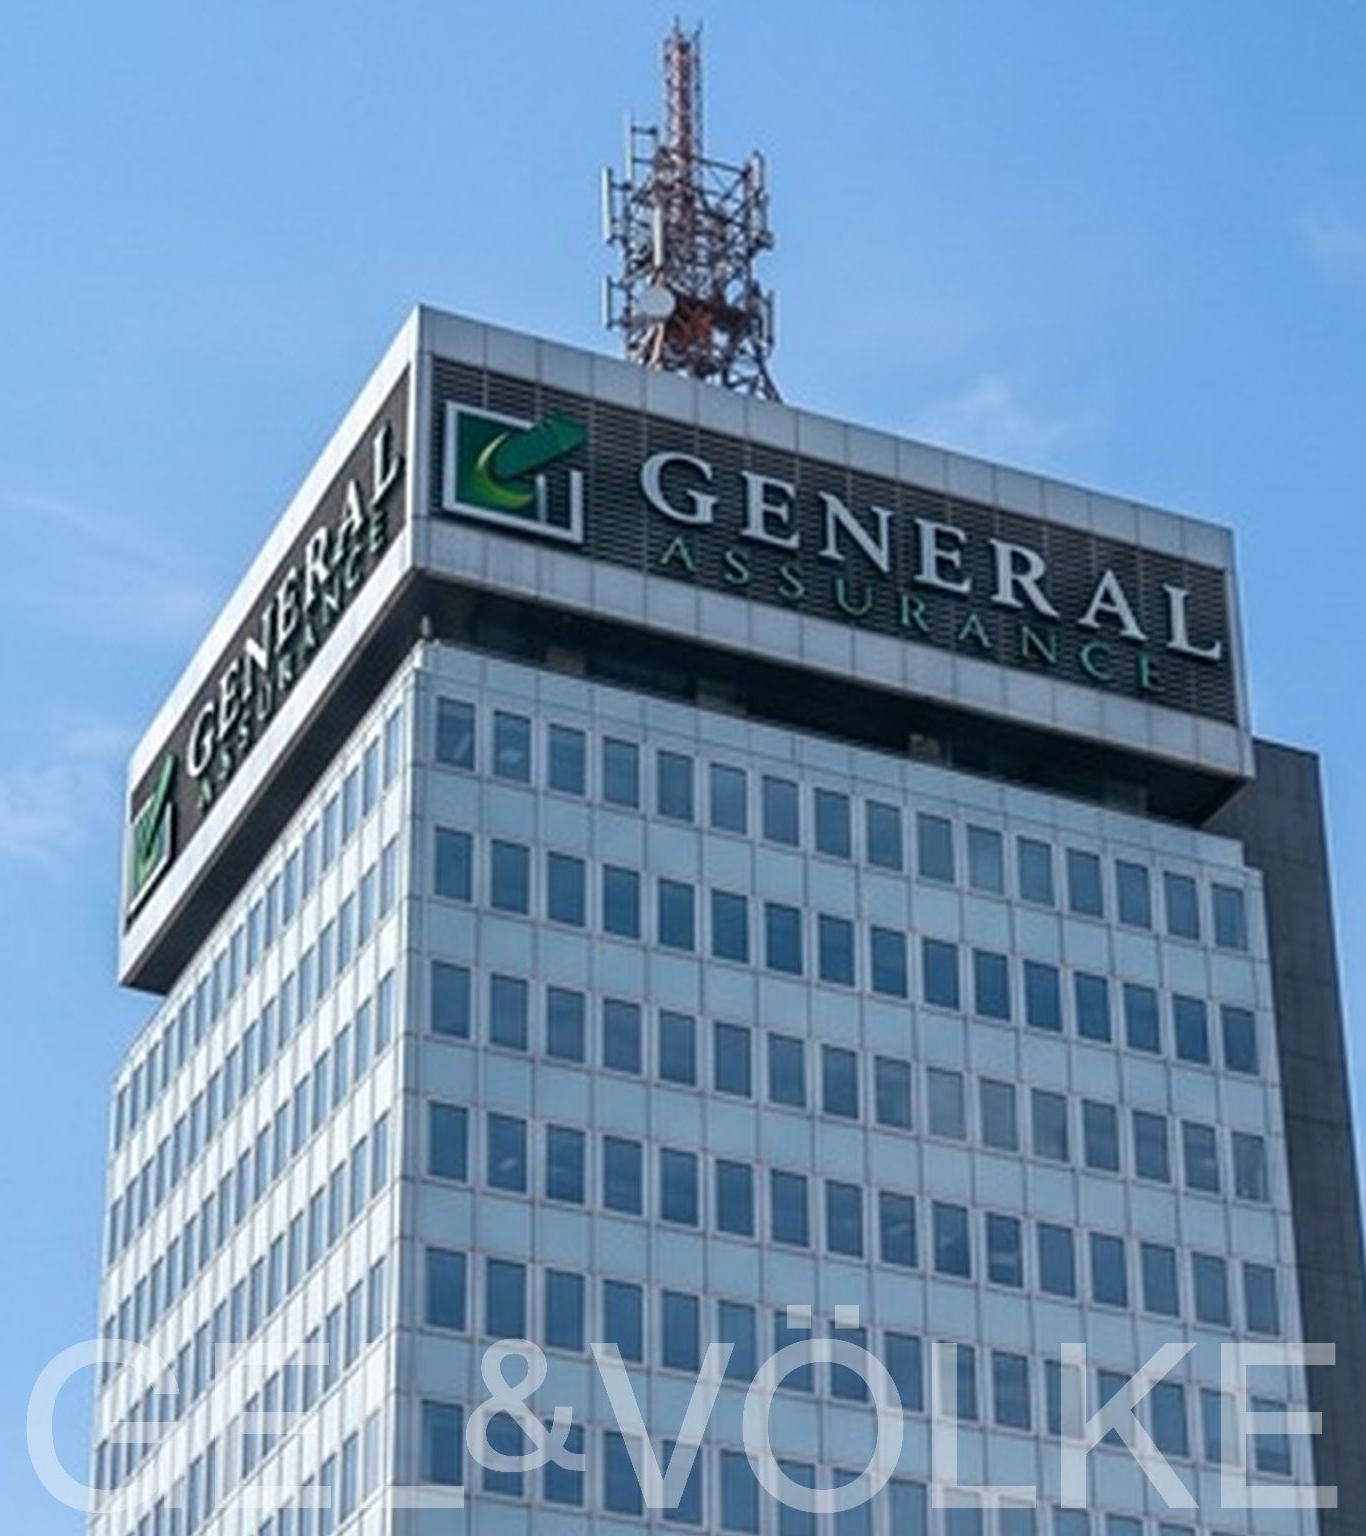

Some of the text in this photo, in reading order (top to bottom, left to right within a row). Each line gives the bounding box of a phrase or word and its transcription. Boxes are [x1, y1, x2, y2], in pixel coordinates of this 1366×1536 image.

[187, 426, 401, 777] GENERAL
[640, 450, 1223, 660] GENERAL
[659, 536, 1163, 692] ASSURANCE
